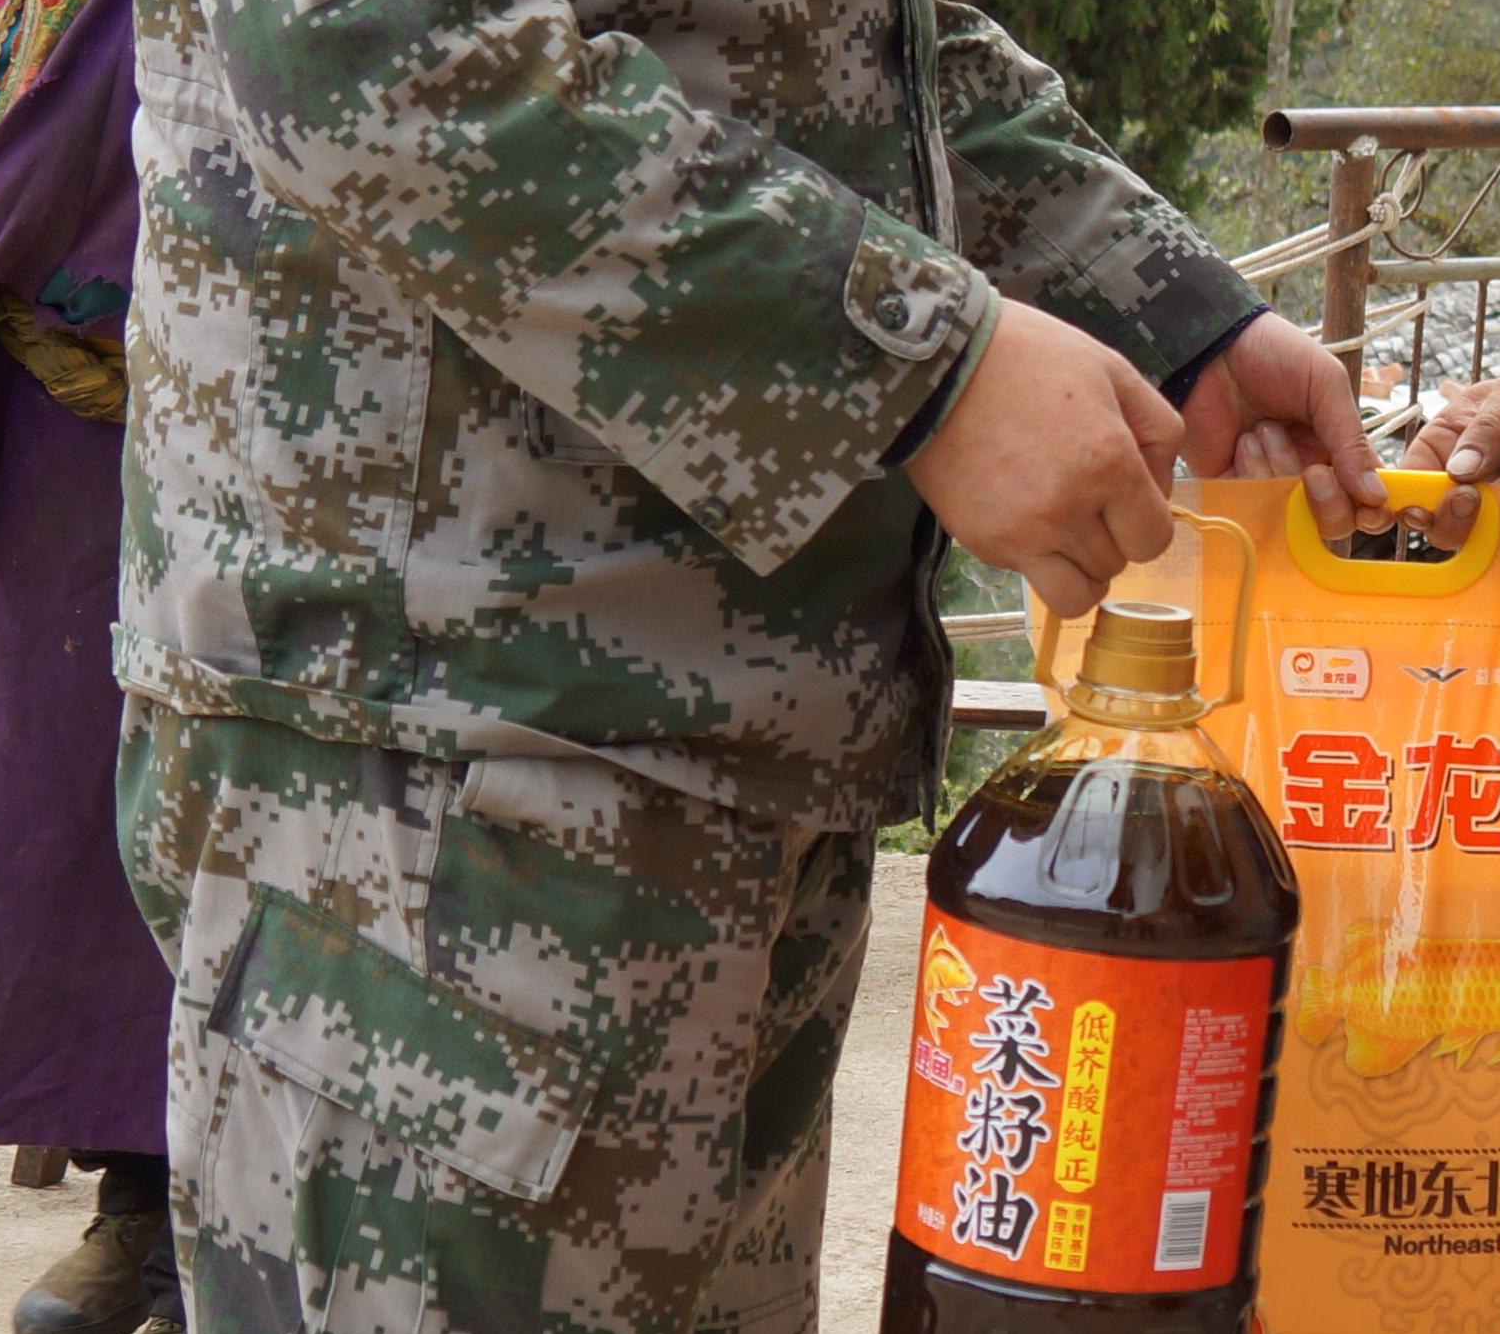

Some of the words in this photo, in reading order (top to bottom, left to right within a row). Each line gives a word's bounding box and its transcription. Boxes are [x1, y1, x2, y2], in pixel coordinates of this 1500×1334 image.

[953, 975, 1060, 1260] 菜籽油
[1059, 1011, 1110, 1184] 低芥酸纯正
